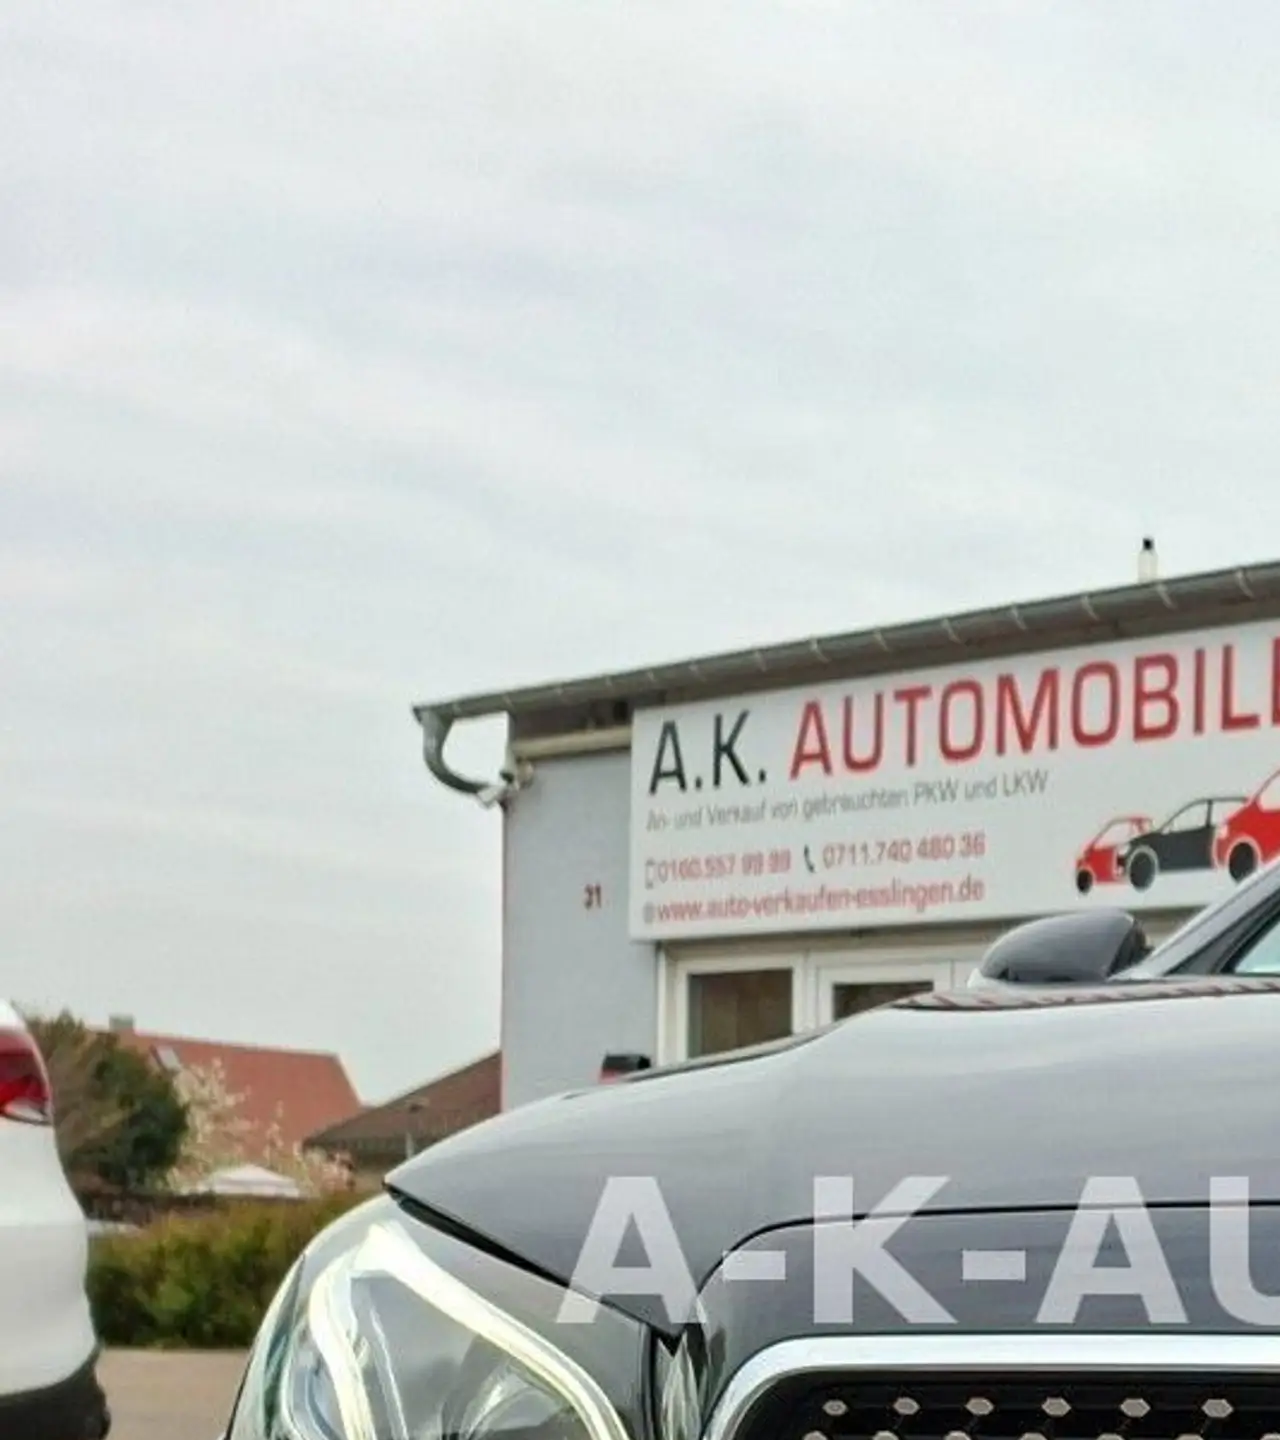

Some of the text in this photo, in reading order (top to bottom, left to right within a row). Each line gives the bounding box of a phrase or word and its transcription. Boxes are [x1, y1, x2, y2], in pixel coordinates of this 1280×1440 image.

[649, 711, 768, 796] A.K.
[674, 806, 703, 830] und
[707, 799, 767, 825] Verkauf
[770, 799, 798, 821] von
[802, 789, 910, 823] gebrauchten
[912, 777, 958, 804] PKW
[964, 777, 998, 799] und
[1002, 768, 1048, 797] LKW
